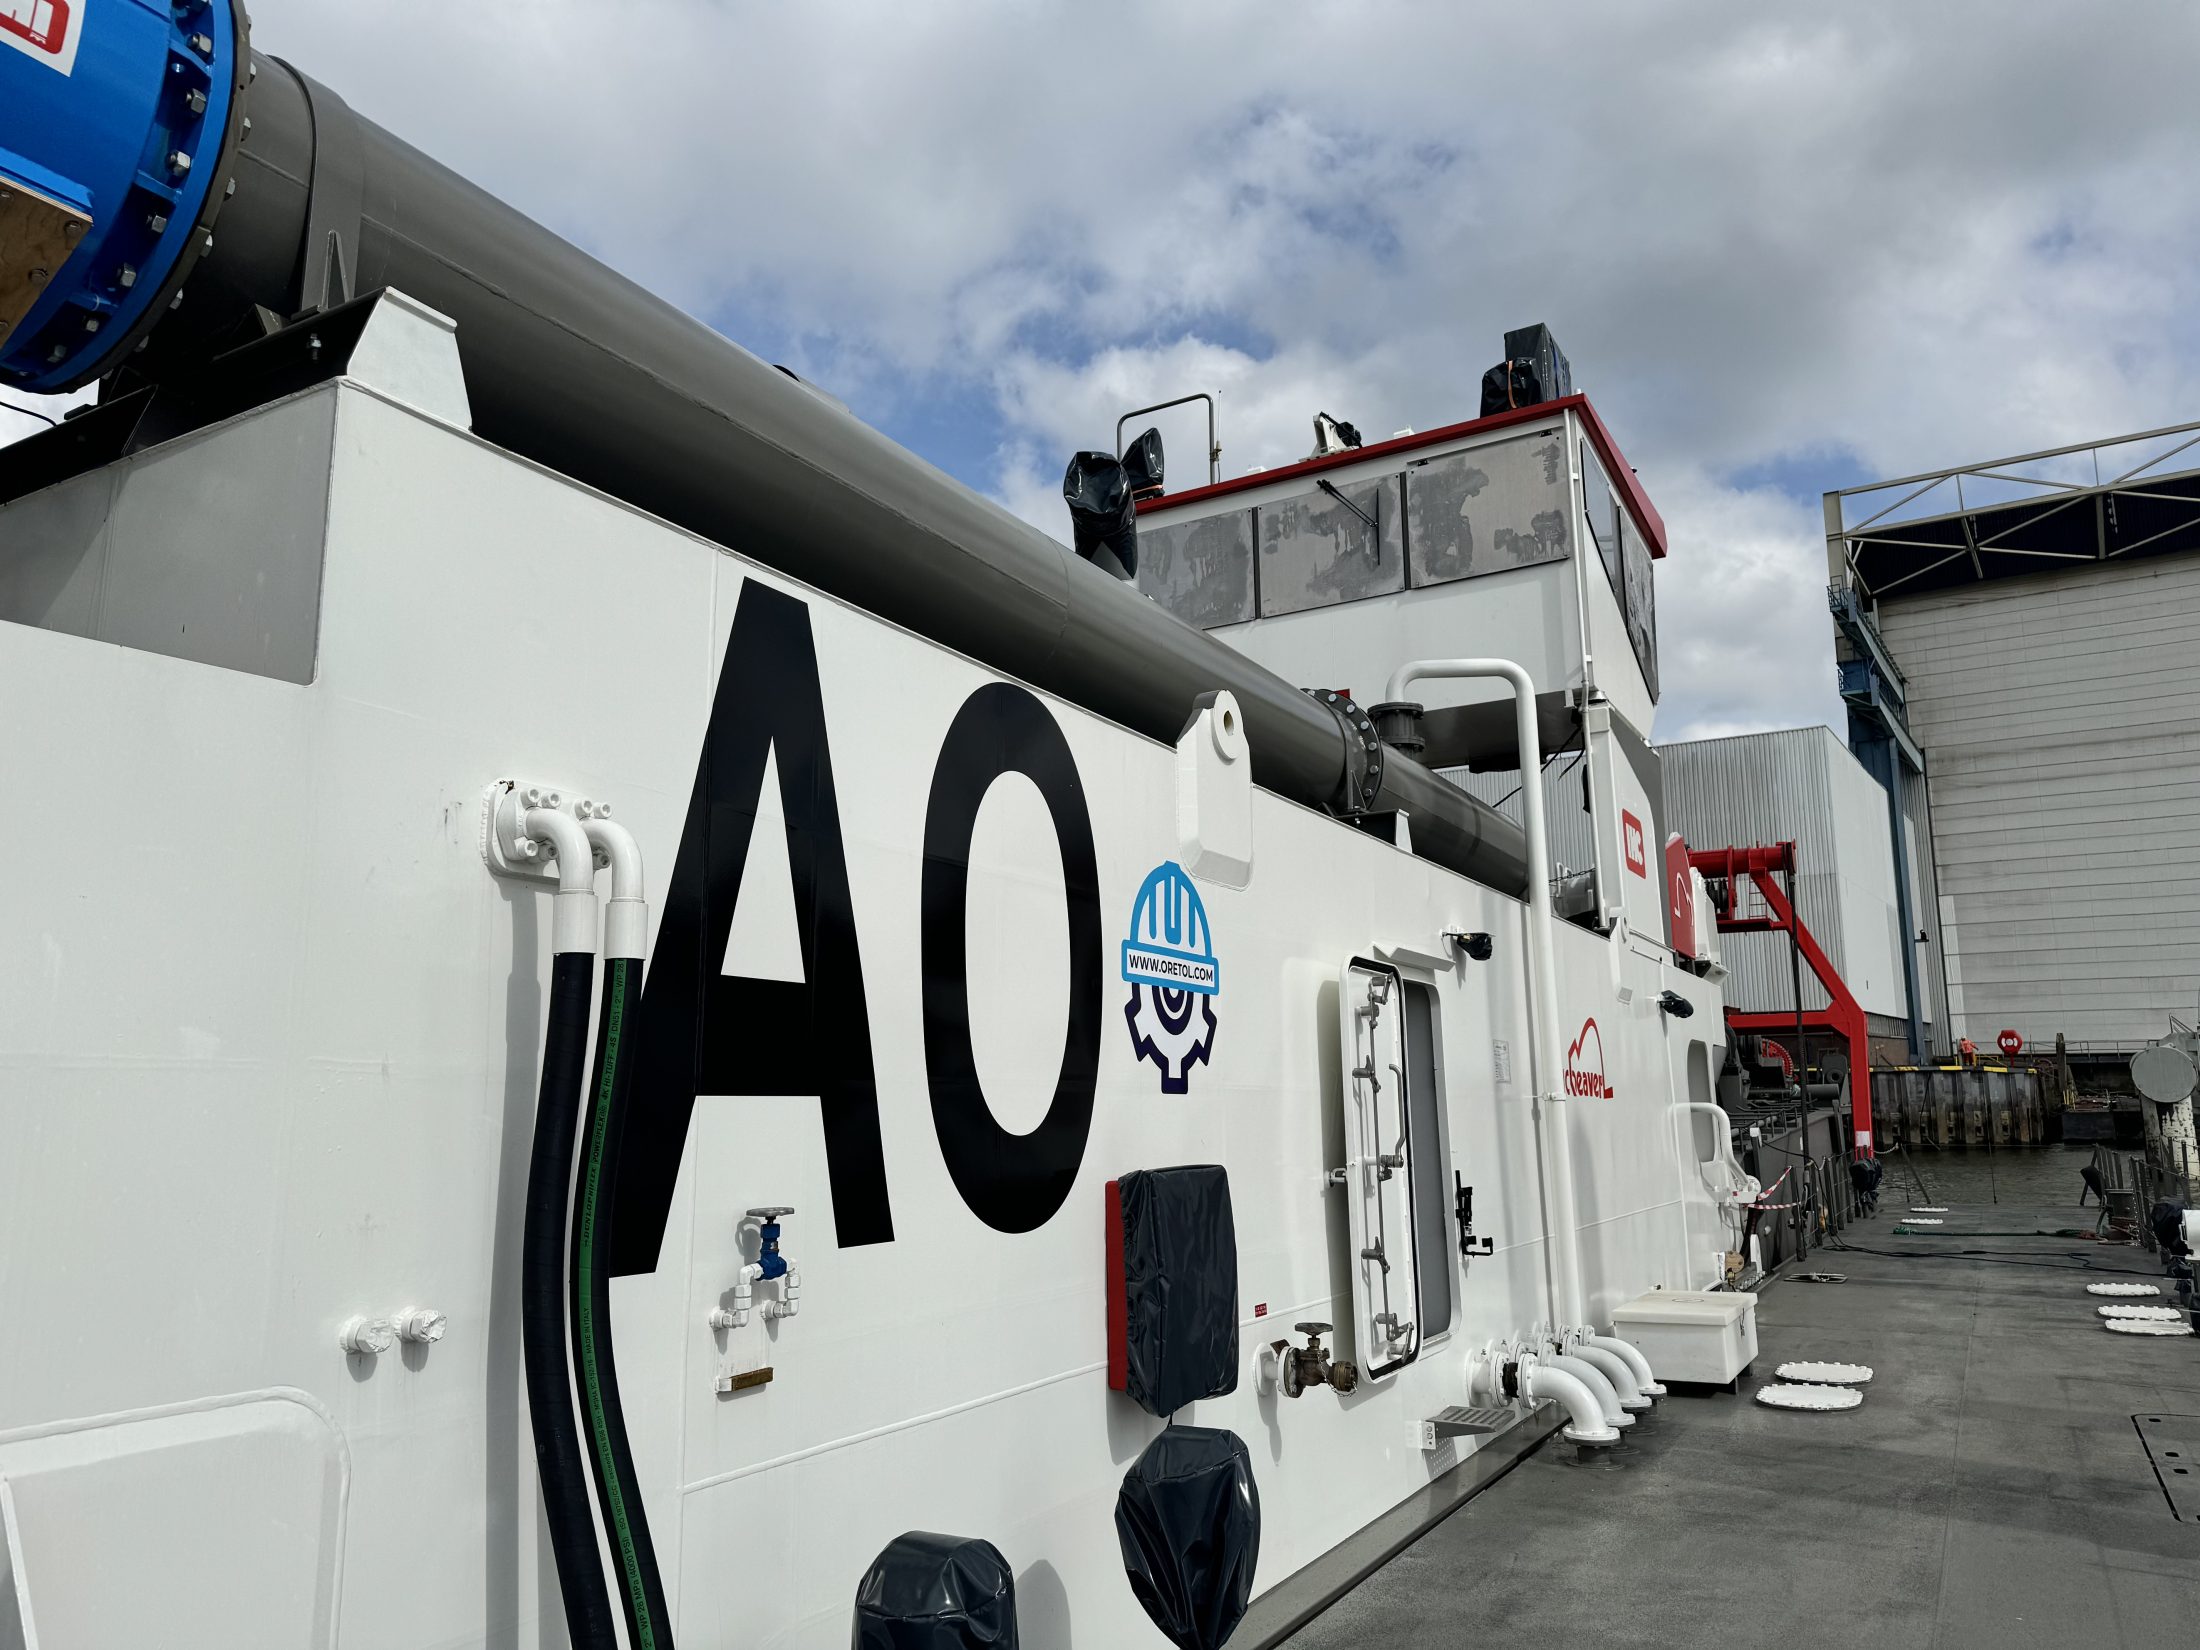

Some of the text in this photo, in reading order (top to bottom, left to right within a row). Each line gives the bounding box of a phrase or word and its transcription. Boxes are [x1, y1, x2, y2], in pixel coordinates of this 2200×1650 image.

[617, 962, 624, 973] 28
[1129, 953, 1213, 982] WWW.ORETOL.COM
[615, 973, 623, 988] WP
[610, 1010, 620, 1032] DN51
[602, 1053, 614, 1086] HI-TUFF
[591, 1116, 604, 1163] POWERFLEX
[584, 1334, 592, 1354] MADE
[617, 1516, 626, 1530] ISO
[620, 1535, 632, 1554] PSI)
[624, 1554, 637, 1578] (4000
[630, 1579, 642, 1600] MPa
[635, 1600, 645, 1613] 28
[638, 1613, 648, 1630] WP
